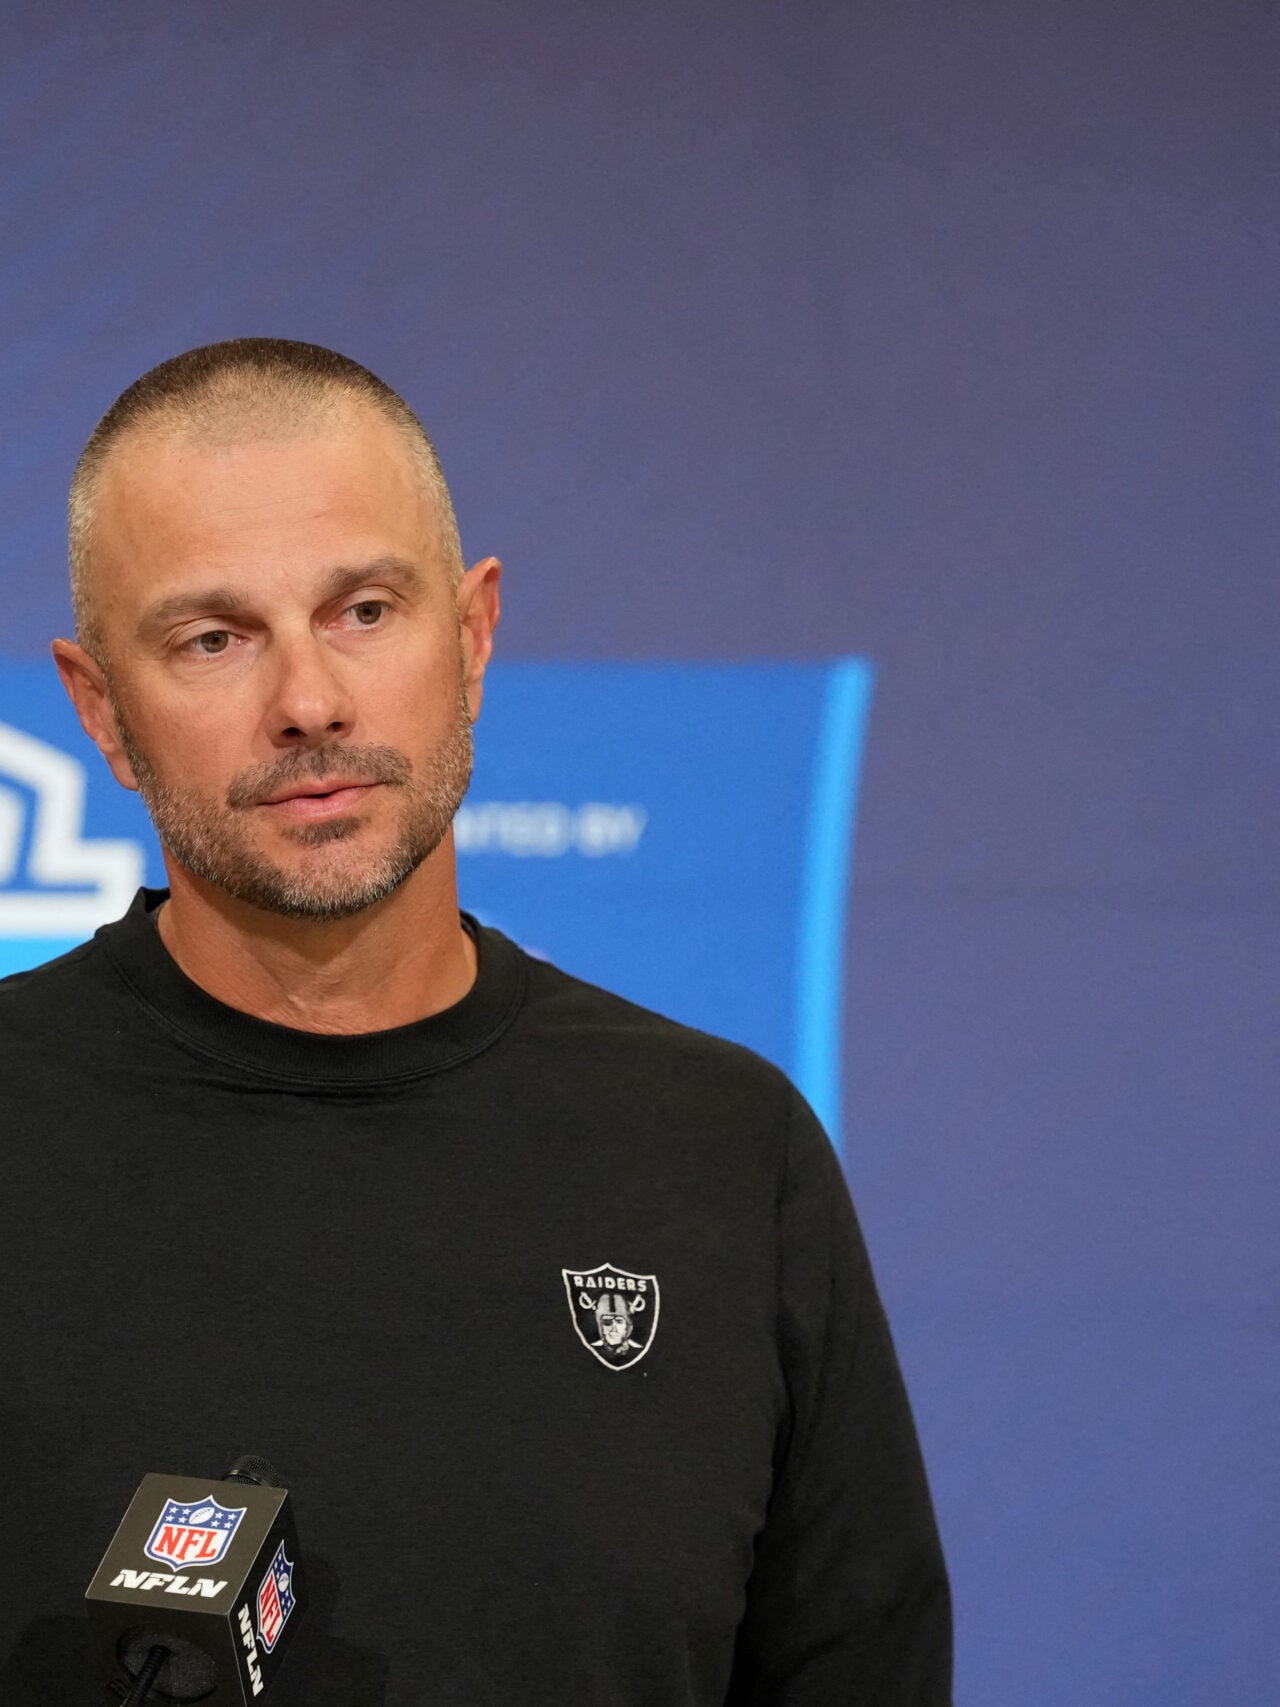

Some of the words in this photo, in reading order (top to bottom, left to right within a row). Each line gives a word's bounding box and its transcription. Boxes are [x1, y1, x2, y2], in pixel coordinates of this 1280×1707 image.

[577, 804, 648, 856] BY
[573, 1276, 647, 1292] RAIDERS
[154, 1526, 218, 1560] NFL
[110, 1569, 228, 1598] NFLN
[260, 1573, 282, 1644] NFL
[237, 1603, 264, 1697] NFLN
